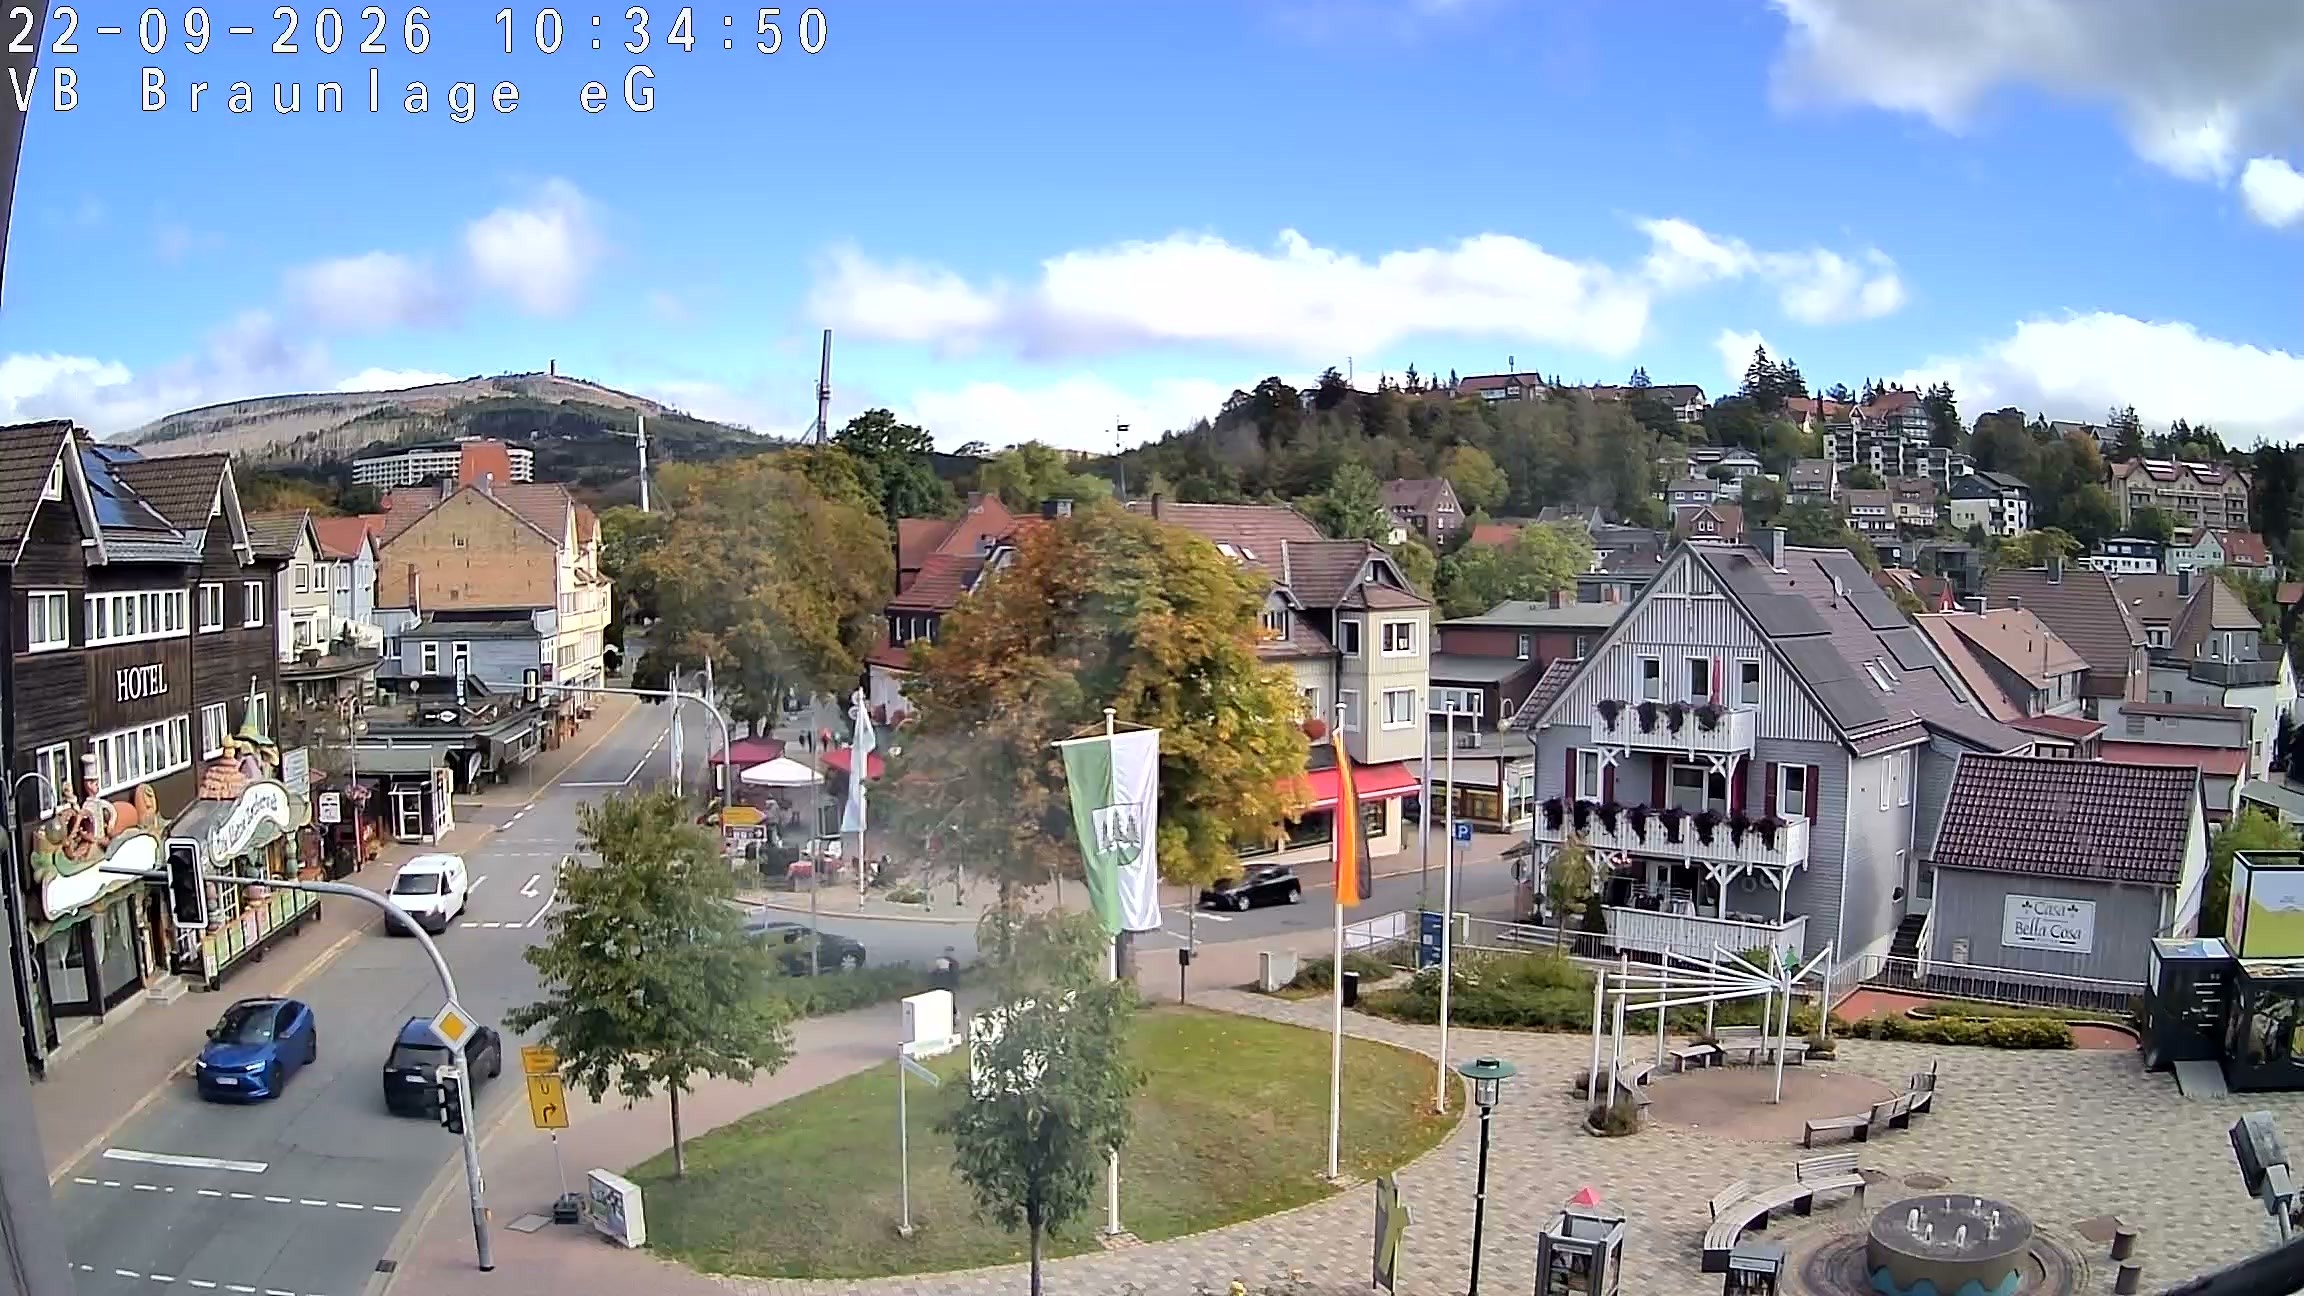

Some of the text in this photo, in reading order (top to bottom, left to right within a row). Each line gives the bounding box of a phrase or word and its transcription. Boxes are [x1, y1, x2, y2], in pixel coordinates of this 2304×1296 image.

[116, 663, 168, 702] HOTEL
[1458, 824, 1468, 839] P
[2034, 901, 2066, 917] Casa
[2015, 917, 2046, 937] Bella
